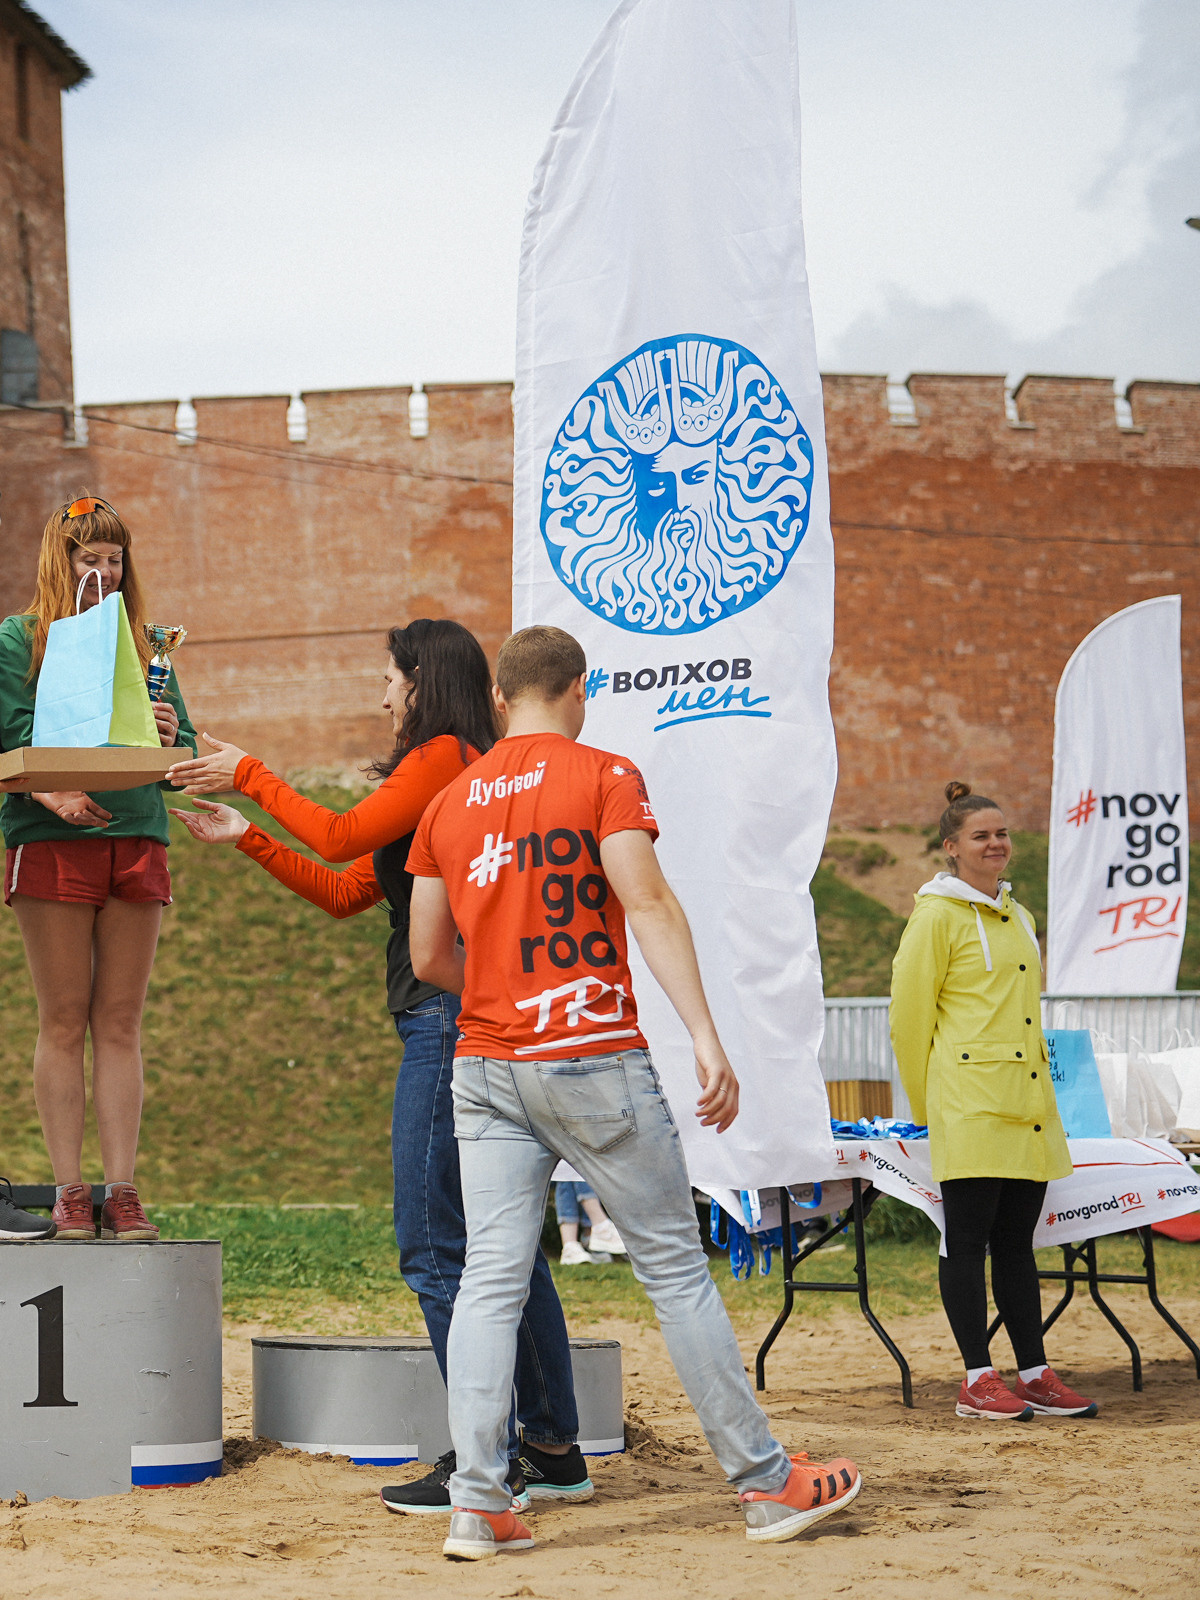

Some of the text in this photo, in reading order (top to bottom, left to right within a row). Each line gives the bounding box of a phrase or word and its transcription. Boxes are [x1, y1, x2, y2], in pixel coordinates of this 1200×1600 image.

[657, 685, 770, 715] мен
[1066, 789, 1181, 827] #nov
[1125, 823, 1180, 858] go
[1107, 846, 1181, 888] rod
[20, 1285, 78, 1407] 1
